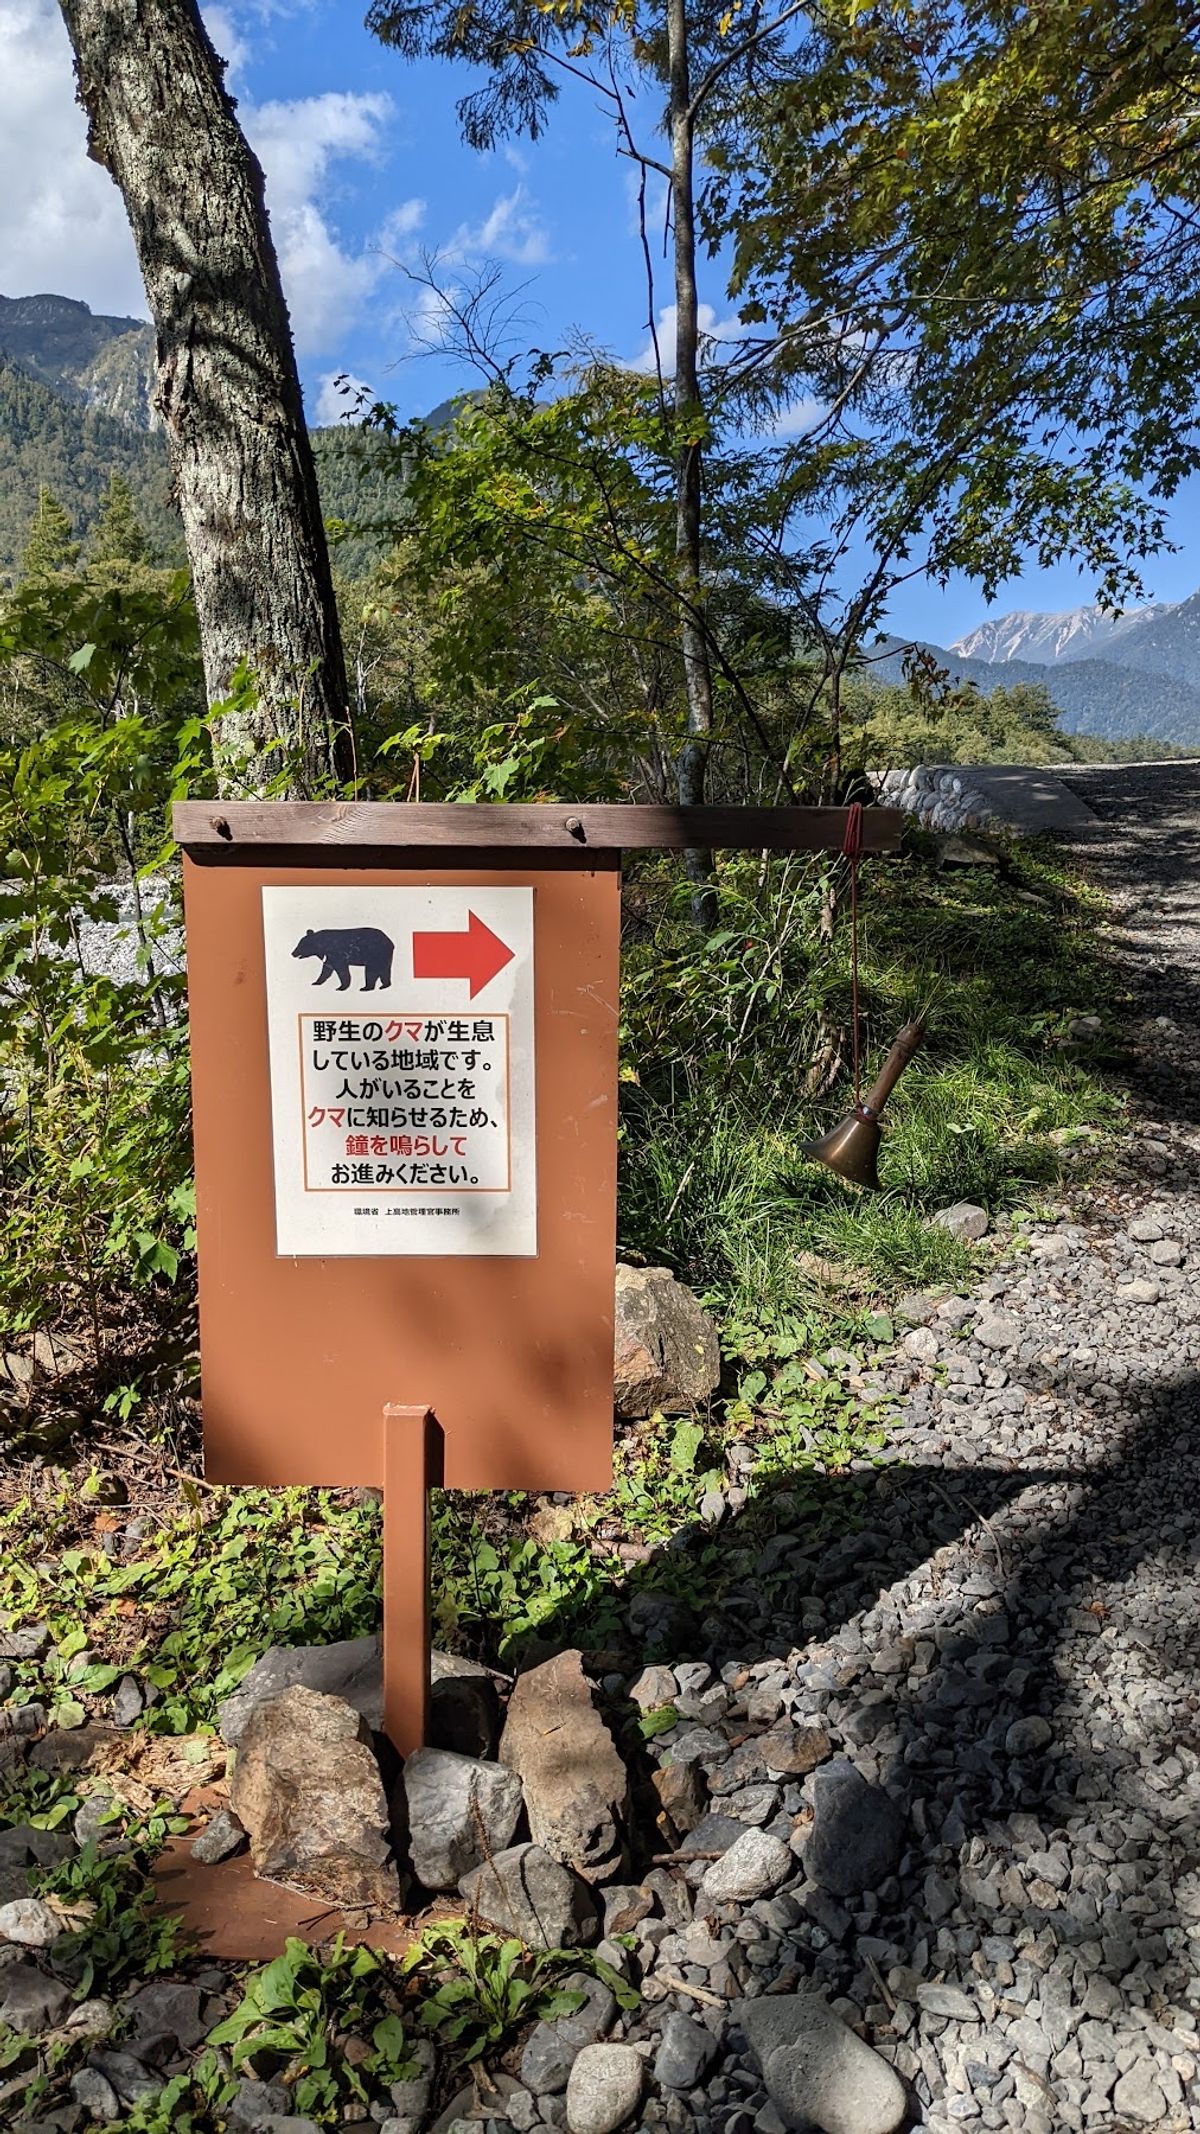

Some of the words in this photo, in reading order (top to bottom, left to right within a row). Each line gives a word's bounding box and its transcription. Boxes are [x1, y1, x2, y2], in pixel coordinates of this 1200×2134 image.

[313, 1020, 495, 1042] 野生のクマが生息
[312, 1049, 492, 1071] している地域です。
[335, 1078, 476, 1100] 人がいることを
[308, 1107, 498, 1128] クマに知らせるため、
[345, 1135, 467, 1156] 鐘を鳴らして
[331, 1163, 479, 1185] お進みください。
[353, 1207, 379, 1216] 環境省
